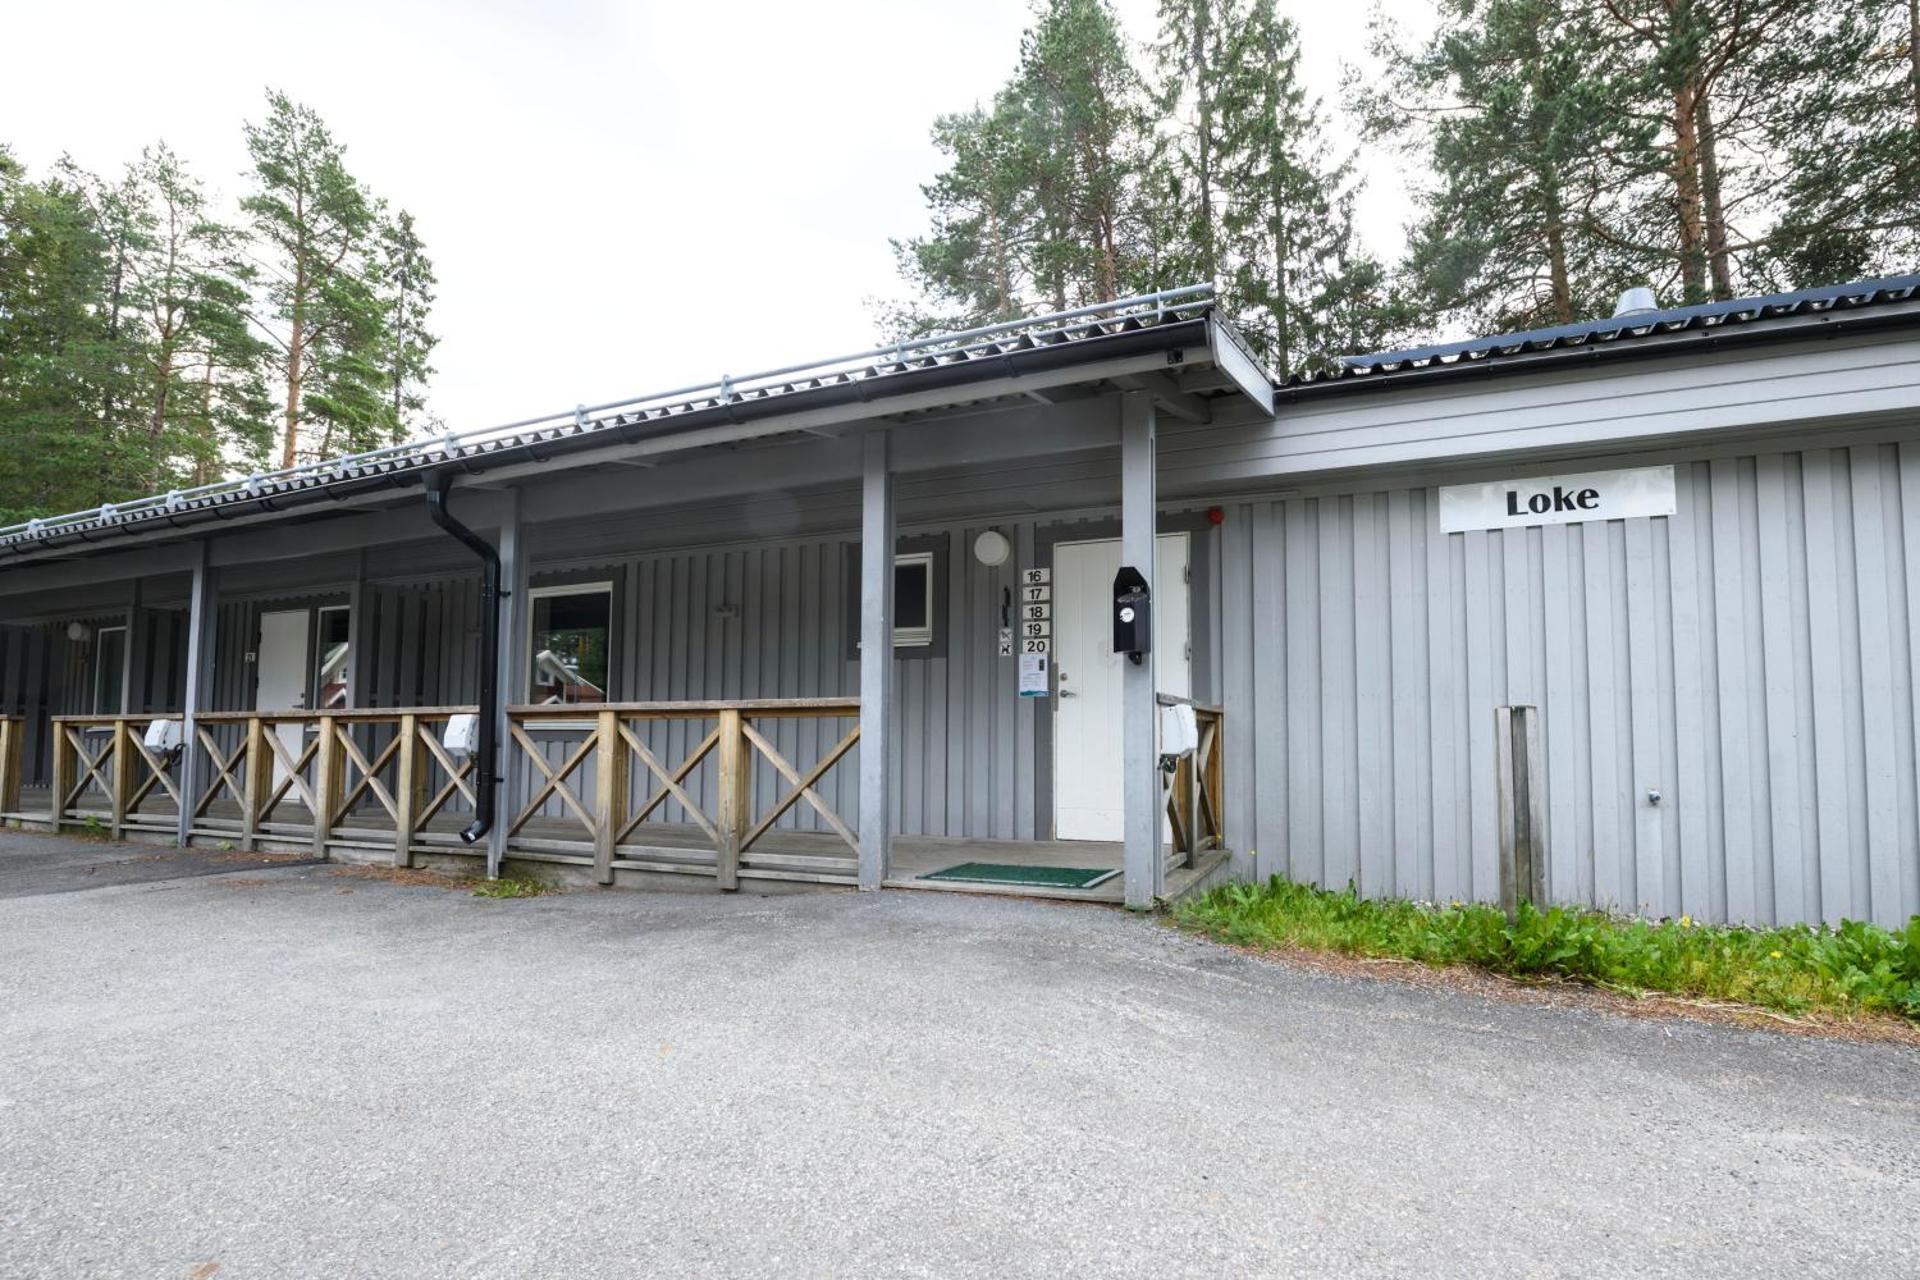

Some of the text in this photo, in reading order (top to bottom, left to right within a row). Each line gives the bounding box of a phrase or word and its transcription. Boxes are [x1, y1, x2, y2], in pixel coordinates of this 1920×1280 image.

[1506, 486, 1600, 516] Loke
[1027, 570, 1042, 582] 16
[1029, 588, 1042, 600] 17
[1029, 606, 1043, 618] 18
[1027, 623, 1042, 635] 19
[1027, 640, 1046, 652] 20
